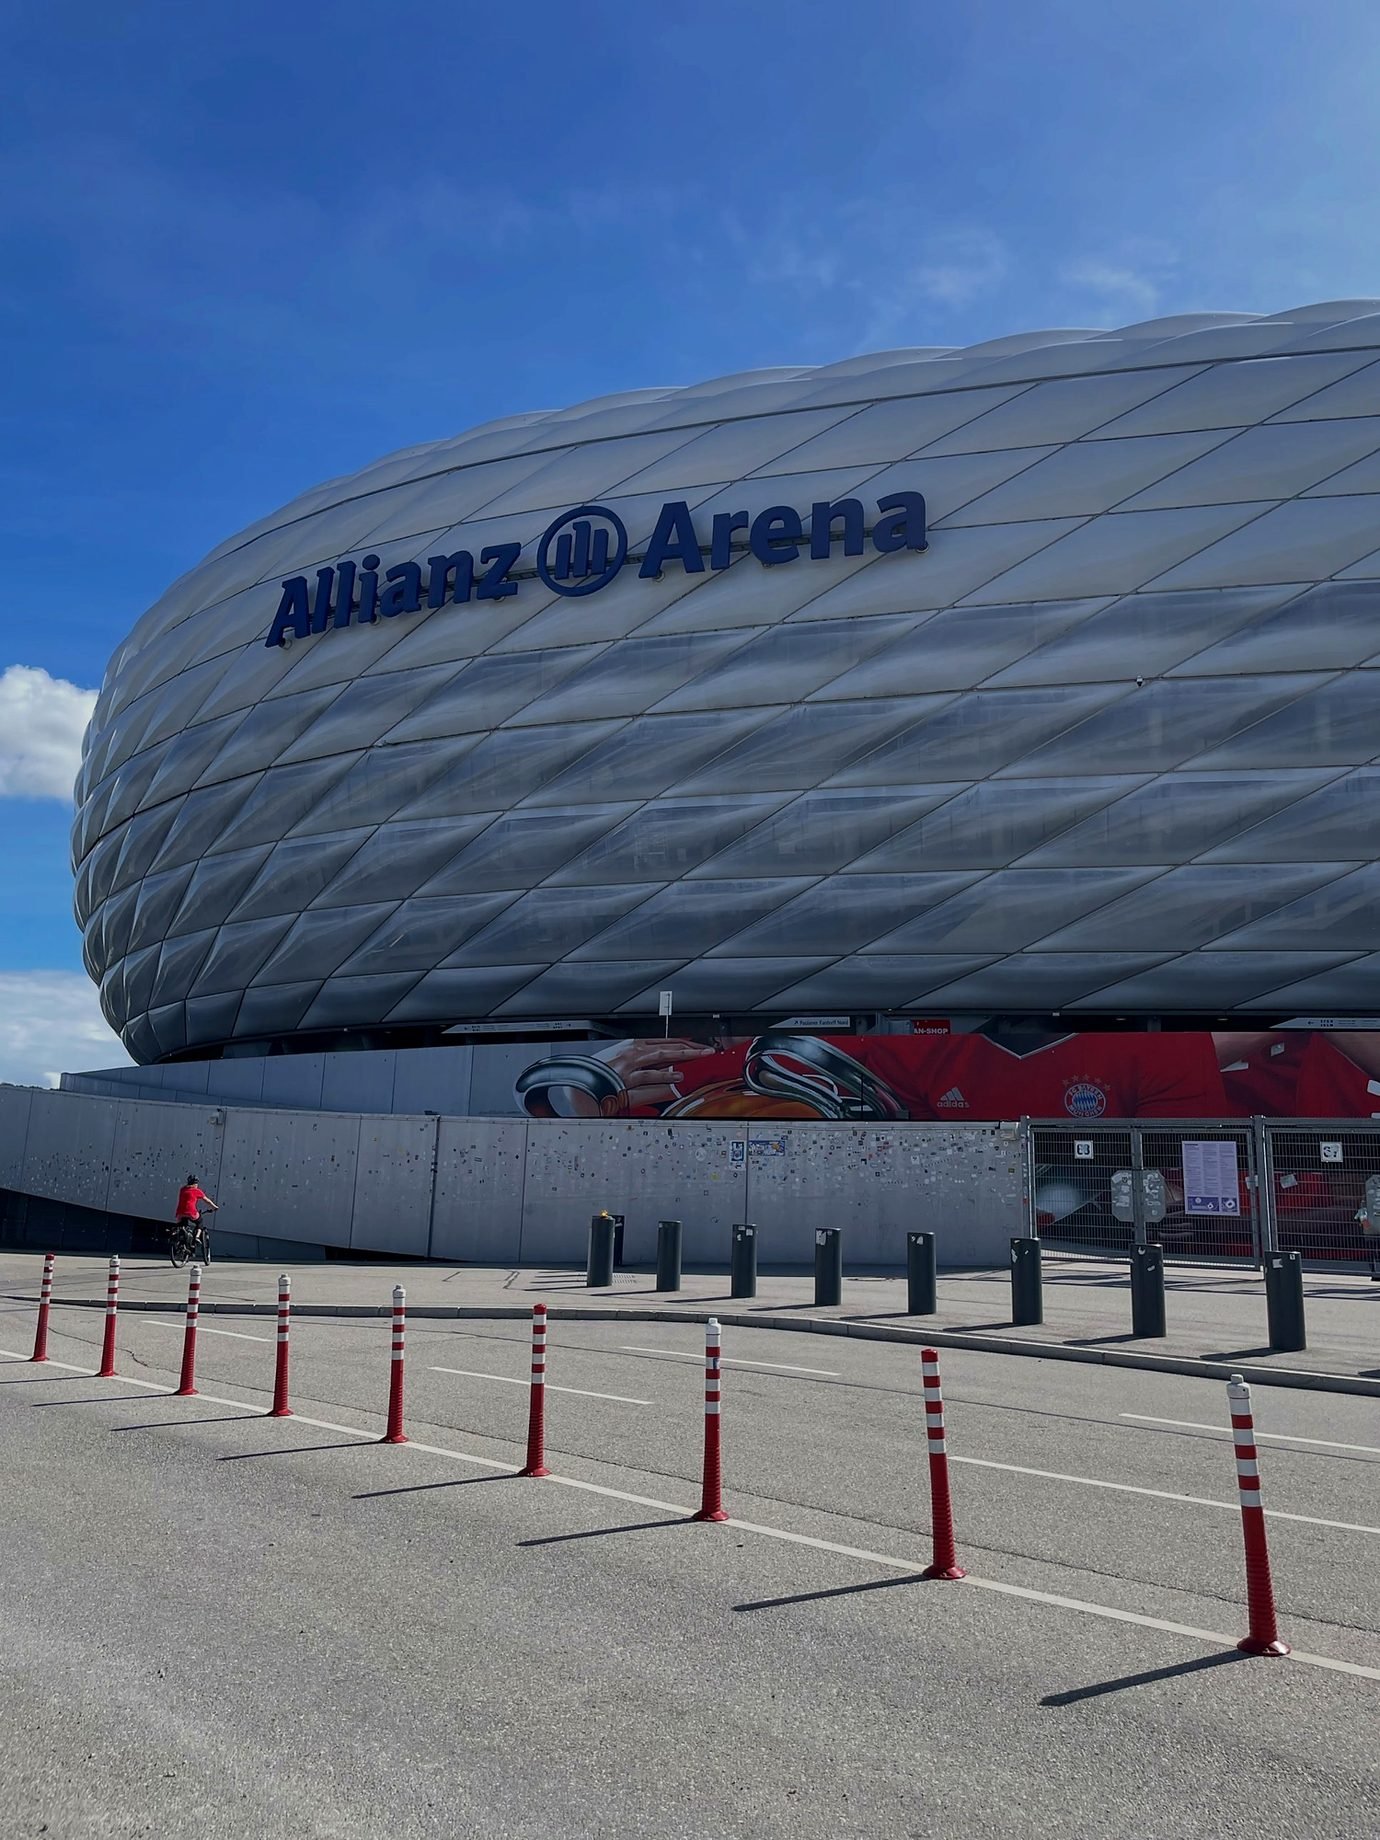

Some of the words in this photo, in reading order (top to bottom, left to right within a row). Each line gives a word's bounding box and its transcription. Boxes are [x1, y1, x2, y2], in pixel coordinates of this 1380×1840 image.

[265, 541, 522, 648] Allianz
[638, 490, 928, 580] Arena
[913, 1027, 949, 1035] AN-SHOP
[936, 1099, 970, 1108] adidas
